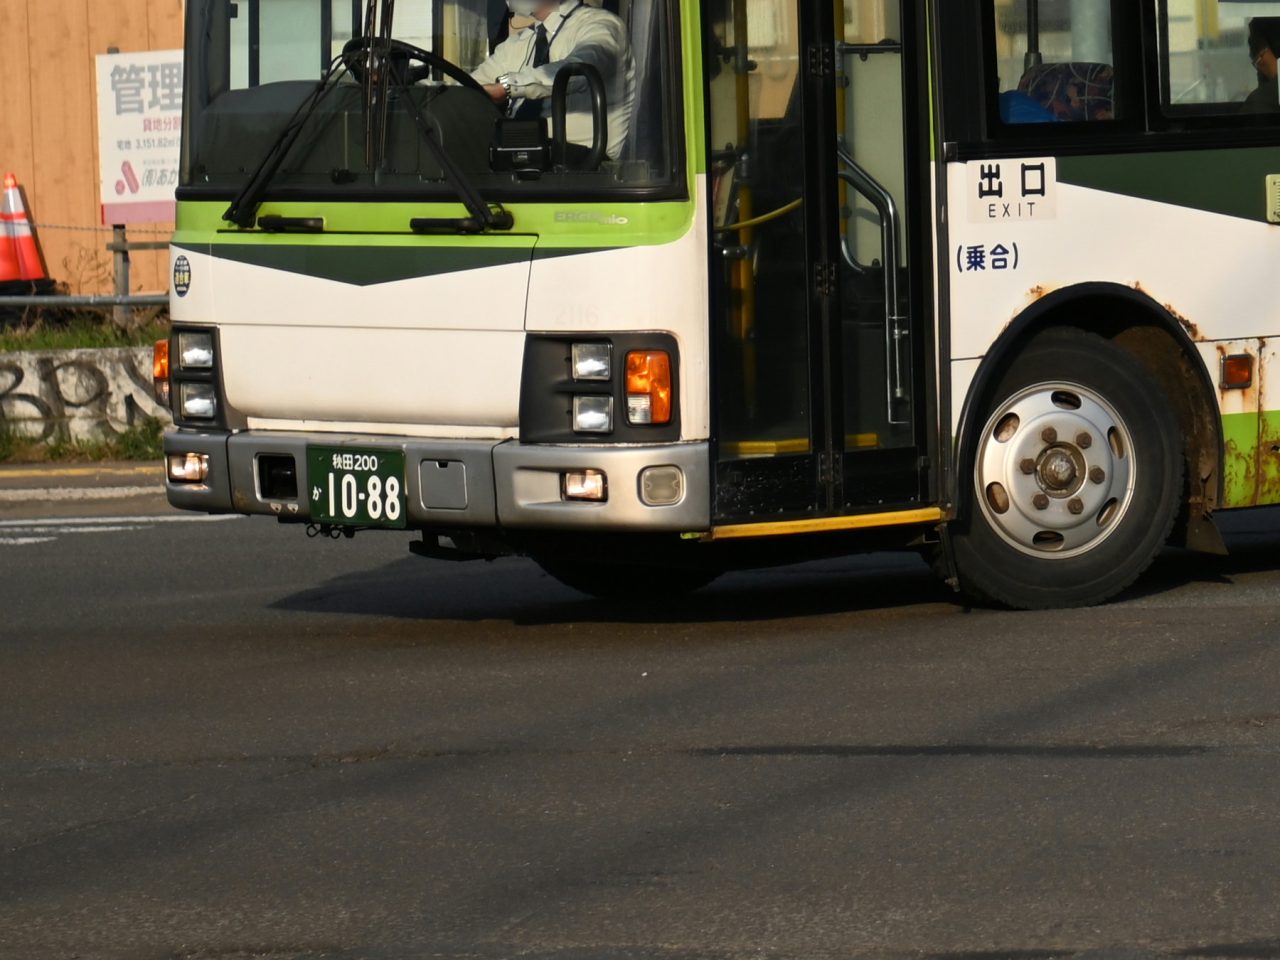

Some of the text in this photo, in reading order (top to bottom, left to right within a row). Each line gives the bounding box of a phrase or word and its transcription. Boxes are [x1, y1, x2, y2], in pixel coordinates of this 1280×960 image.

[110, 62, 183, 116] 管理
[978, 162, 1045, 199] 出口
[988, 202, 1035, 218] EXIT
[957, 242, 1018, 273] (乗合)
[312, 472, 401, 520] か 10-88
